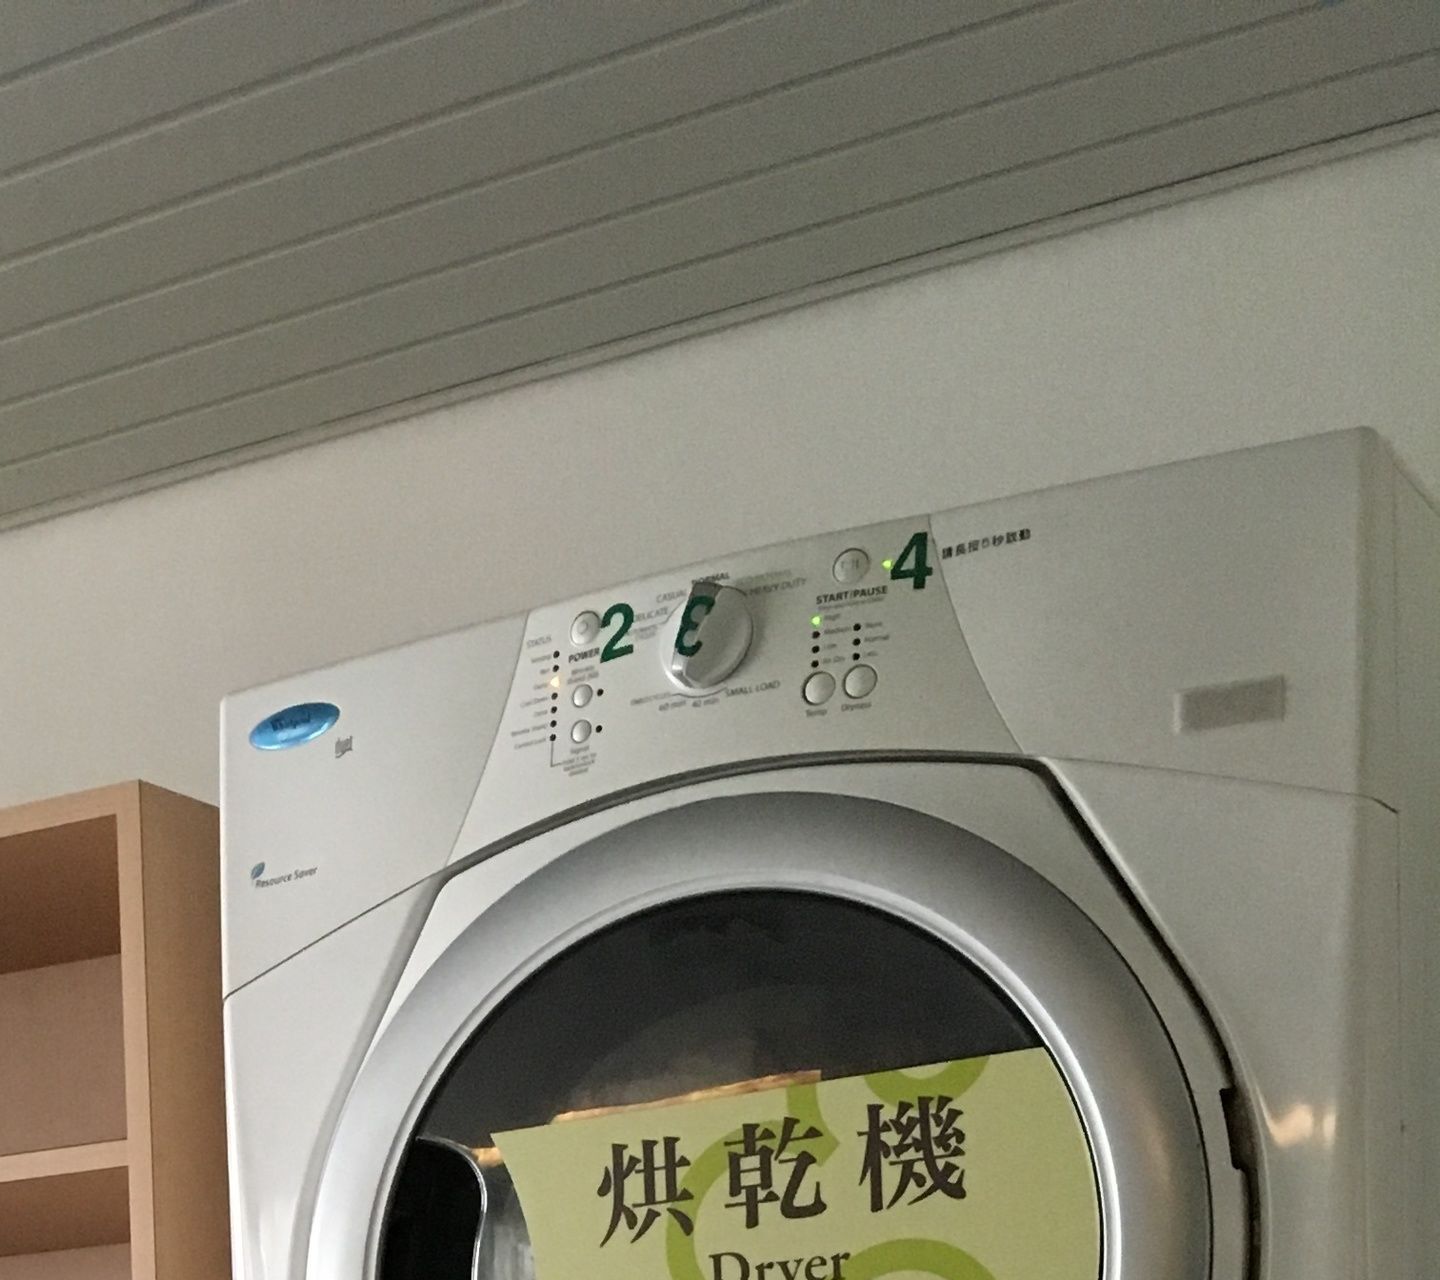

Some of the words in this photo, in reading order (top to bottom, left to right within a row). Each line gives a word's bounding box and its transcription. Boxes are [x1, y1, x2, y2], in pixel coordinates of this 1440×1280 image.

[890, 532, 933, 589] 4
[600, 602, 635, 663] 2
[597, 1095, 967, 1248] 烘乾機
